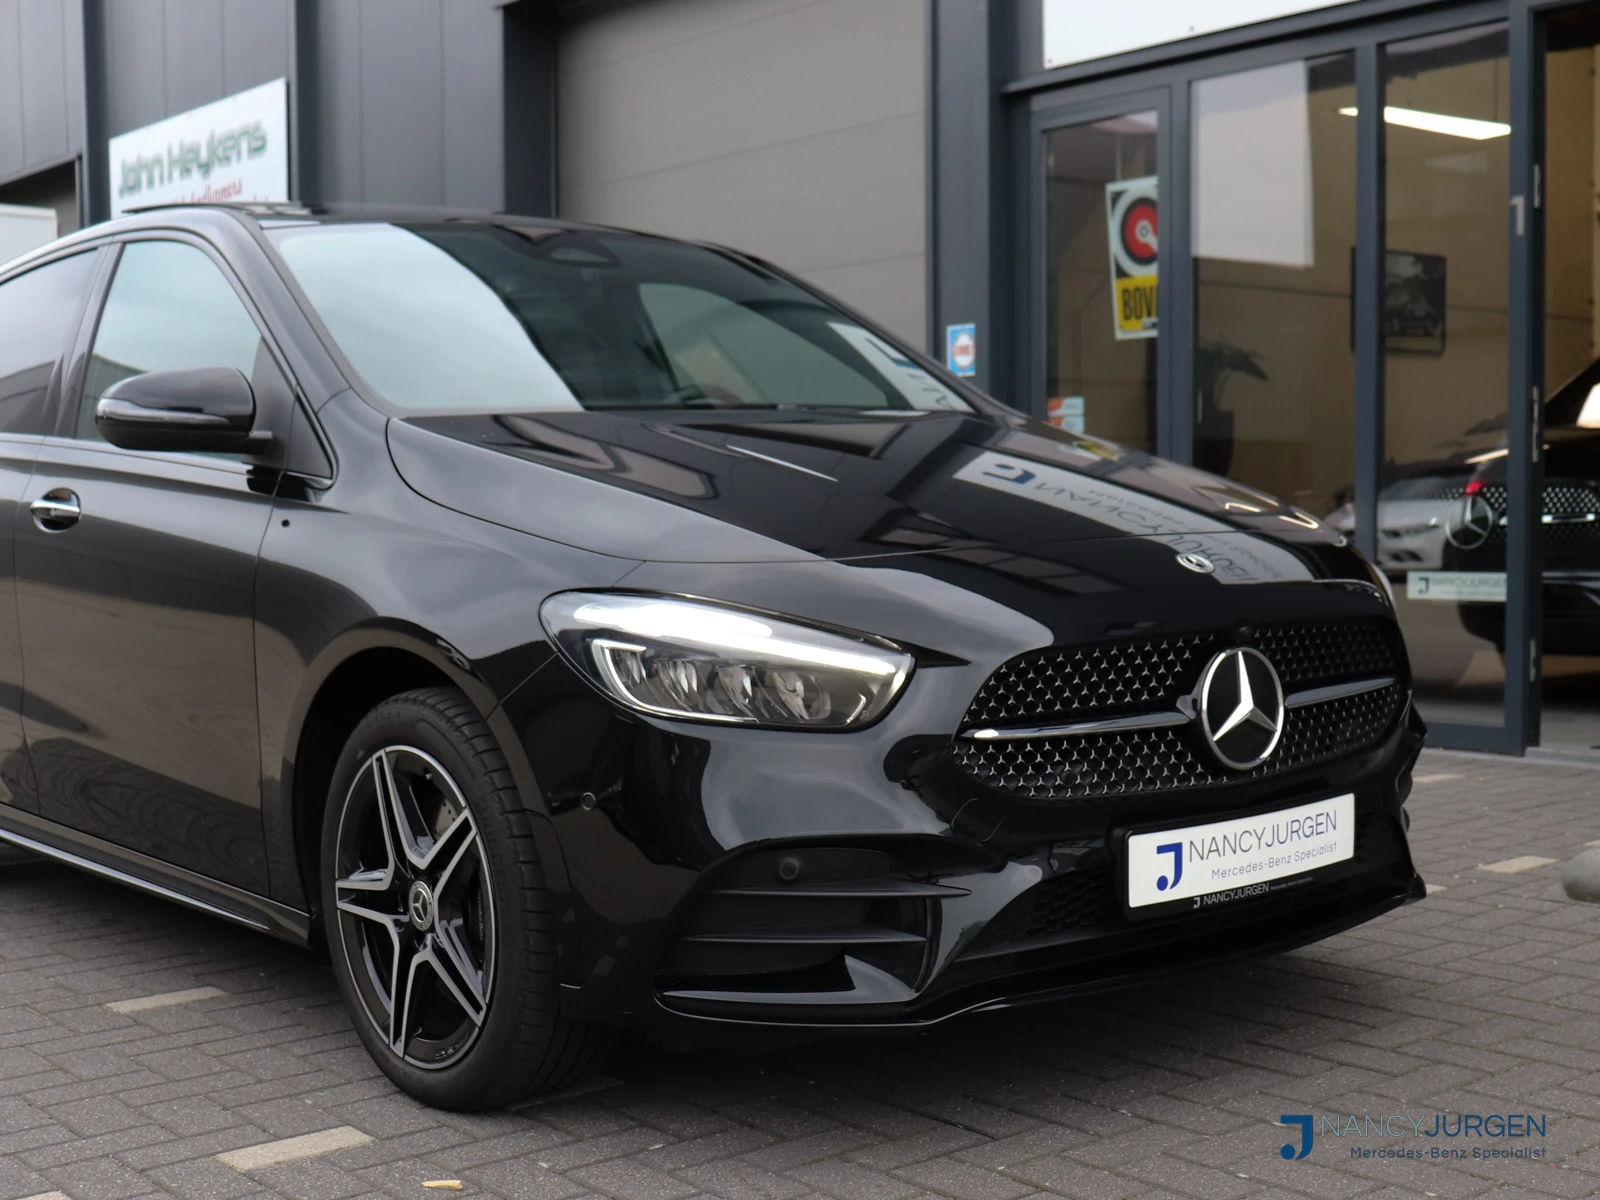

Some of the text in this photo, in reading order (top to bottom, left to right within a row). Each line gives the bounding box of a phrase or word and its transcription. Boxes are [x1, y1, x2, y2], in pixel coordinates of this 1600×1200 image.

[119, 119, 268, 198] John Heykens
[1188, 809, 1338, 864] NANCYJURGEN
[1211, 841, 1338, 880] Mercedes-Benz Specialist
[1203, 882, 1270, 906] NANCYJURGEN
